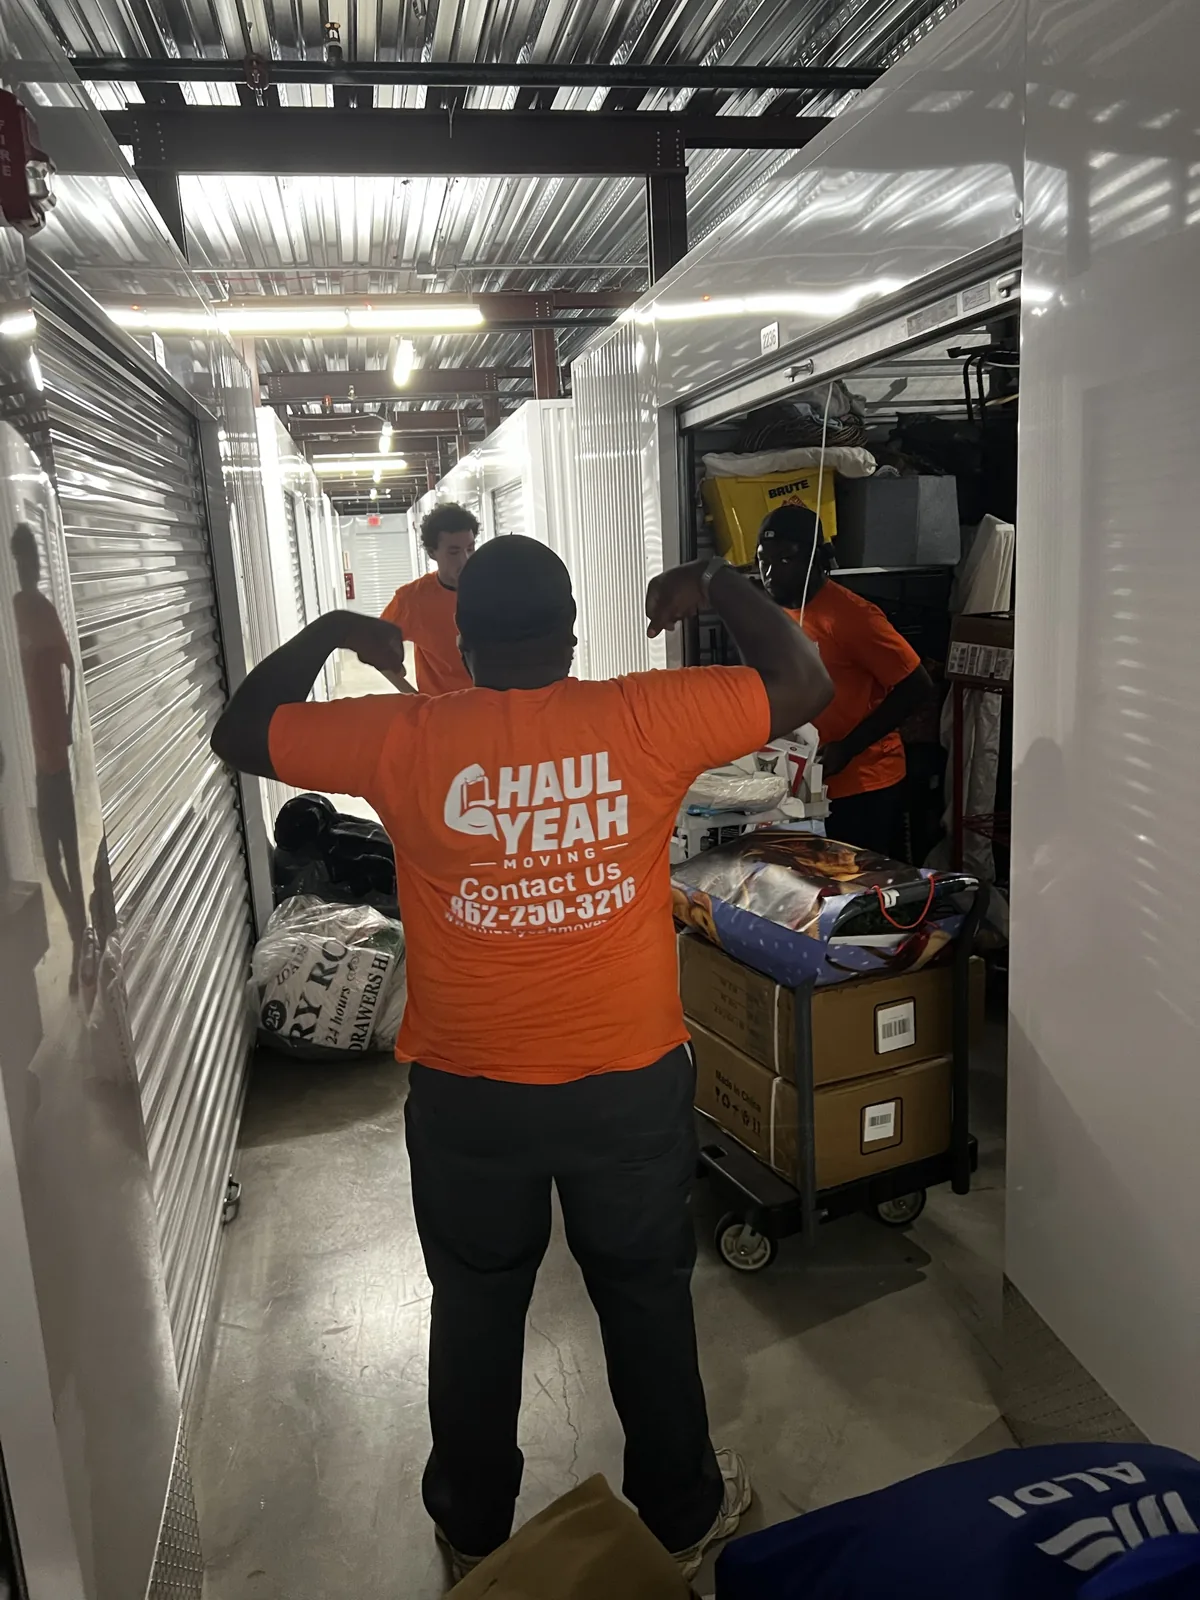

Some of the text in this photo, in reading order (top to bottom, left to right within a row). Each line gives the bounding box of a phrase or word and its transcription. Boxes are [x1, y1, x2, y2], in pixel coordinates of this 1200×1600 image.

[768, 479, 810, 499] BRUTE
[497, 751, 622, 809] HAUL
[496, 794, 629, 855] YEAH
[459, 862, 622, 901] Contact Us
[503, 847, 596, 869] MOVING
[449, 876, 636, 928] 862-250-3216
[325, 985, 351, 1045] 24 hours
[987, 1461, 1146, 1519] ALDI
